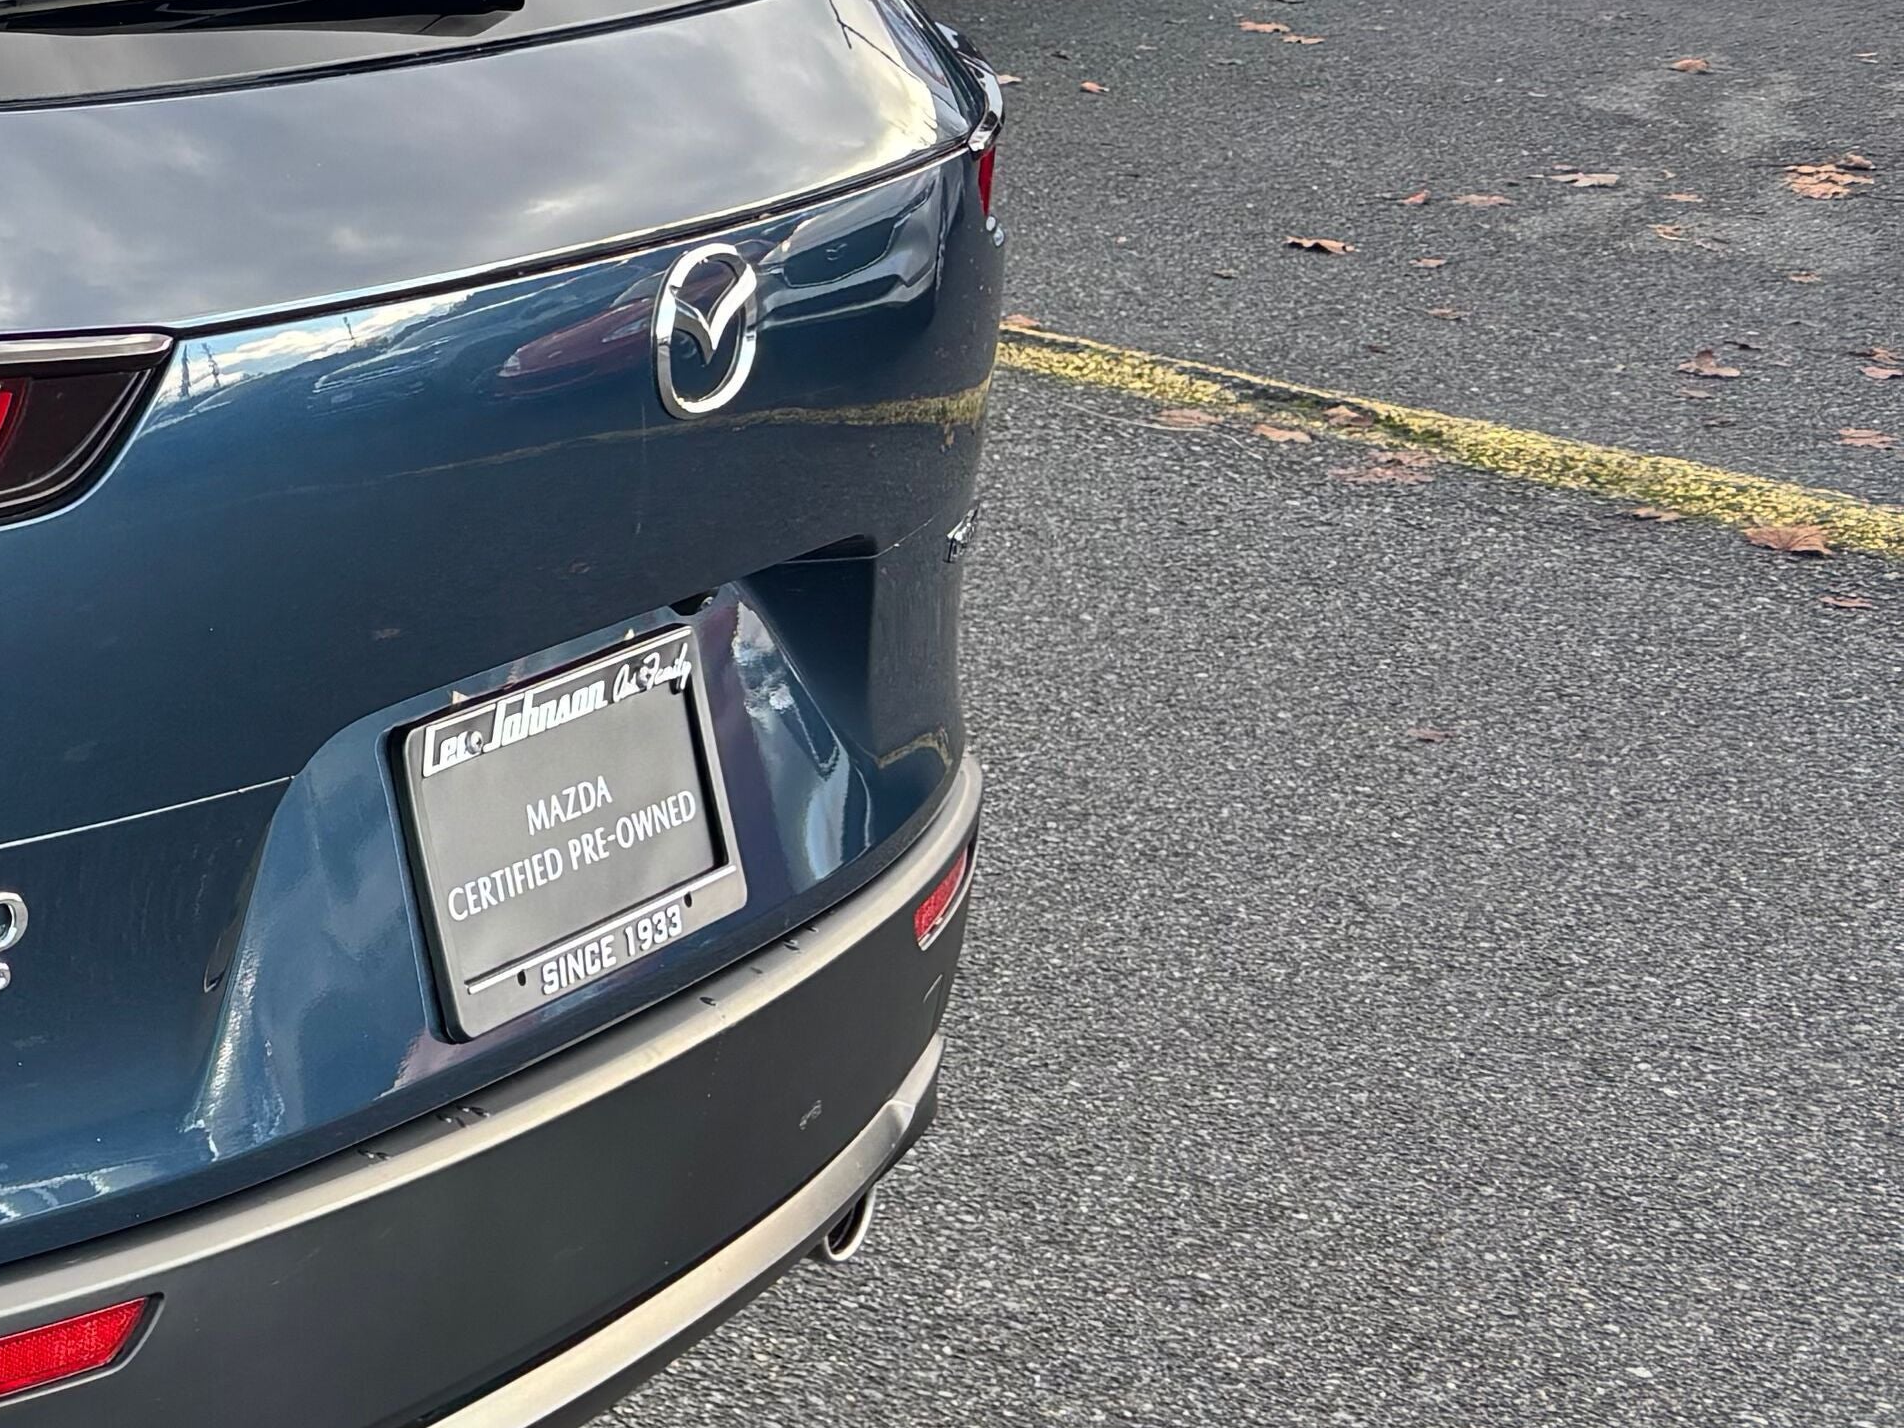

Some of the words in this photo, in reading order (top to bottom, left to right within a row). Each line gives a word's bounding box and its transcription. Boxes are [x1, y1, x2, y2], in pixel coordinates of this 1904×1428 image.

[526, 775, 613, 836] MAZDA
[448, 847, 563, 921] CERTIFIED
[568, 790, 697, 870] PRE-OWNED
[542, 934, 617, 996] SINCE
[624, 904, 684, 957] 1933
